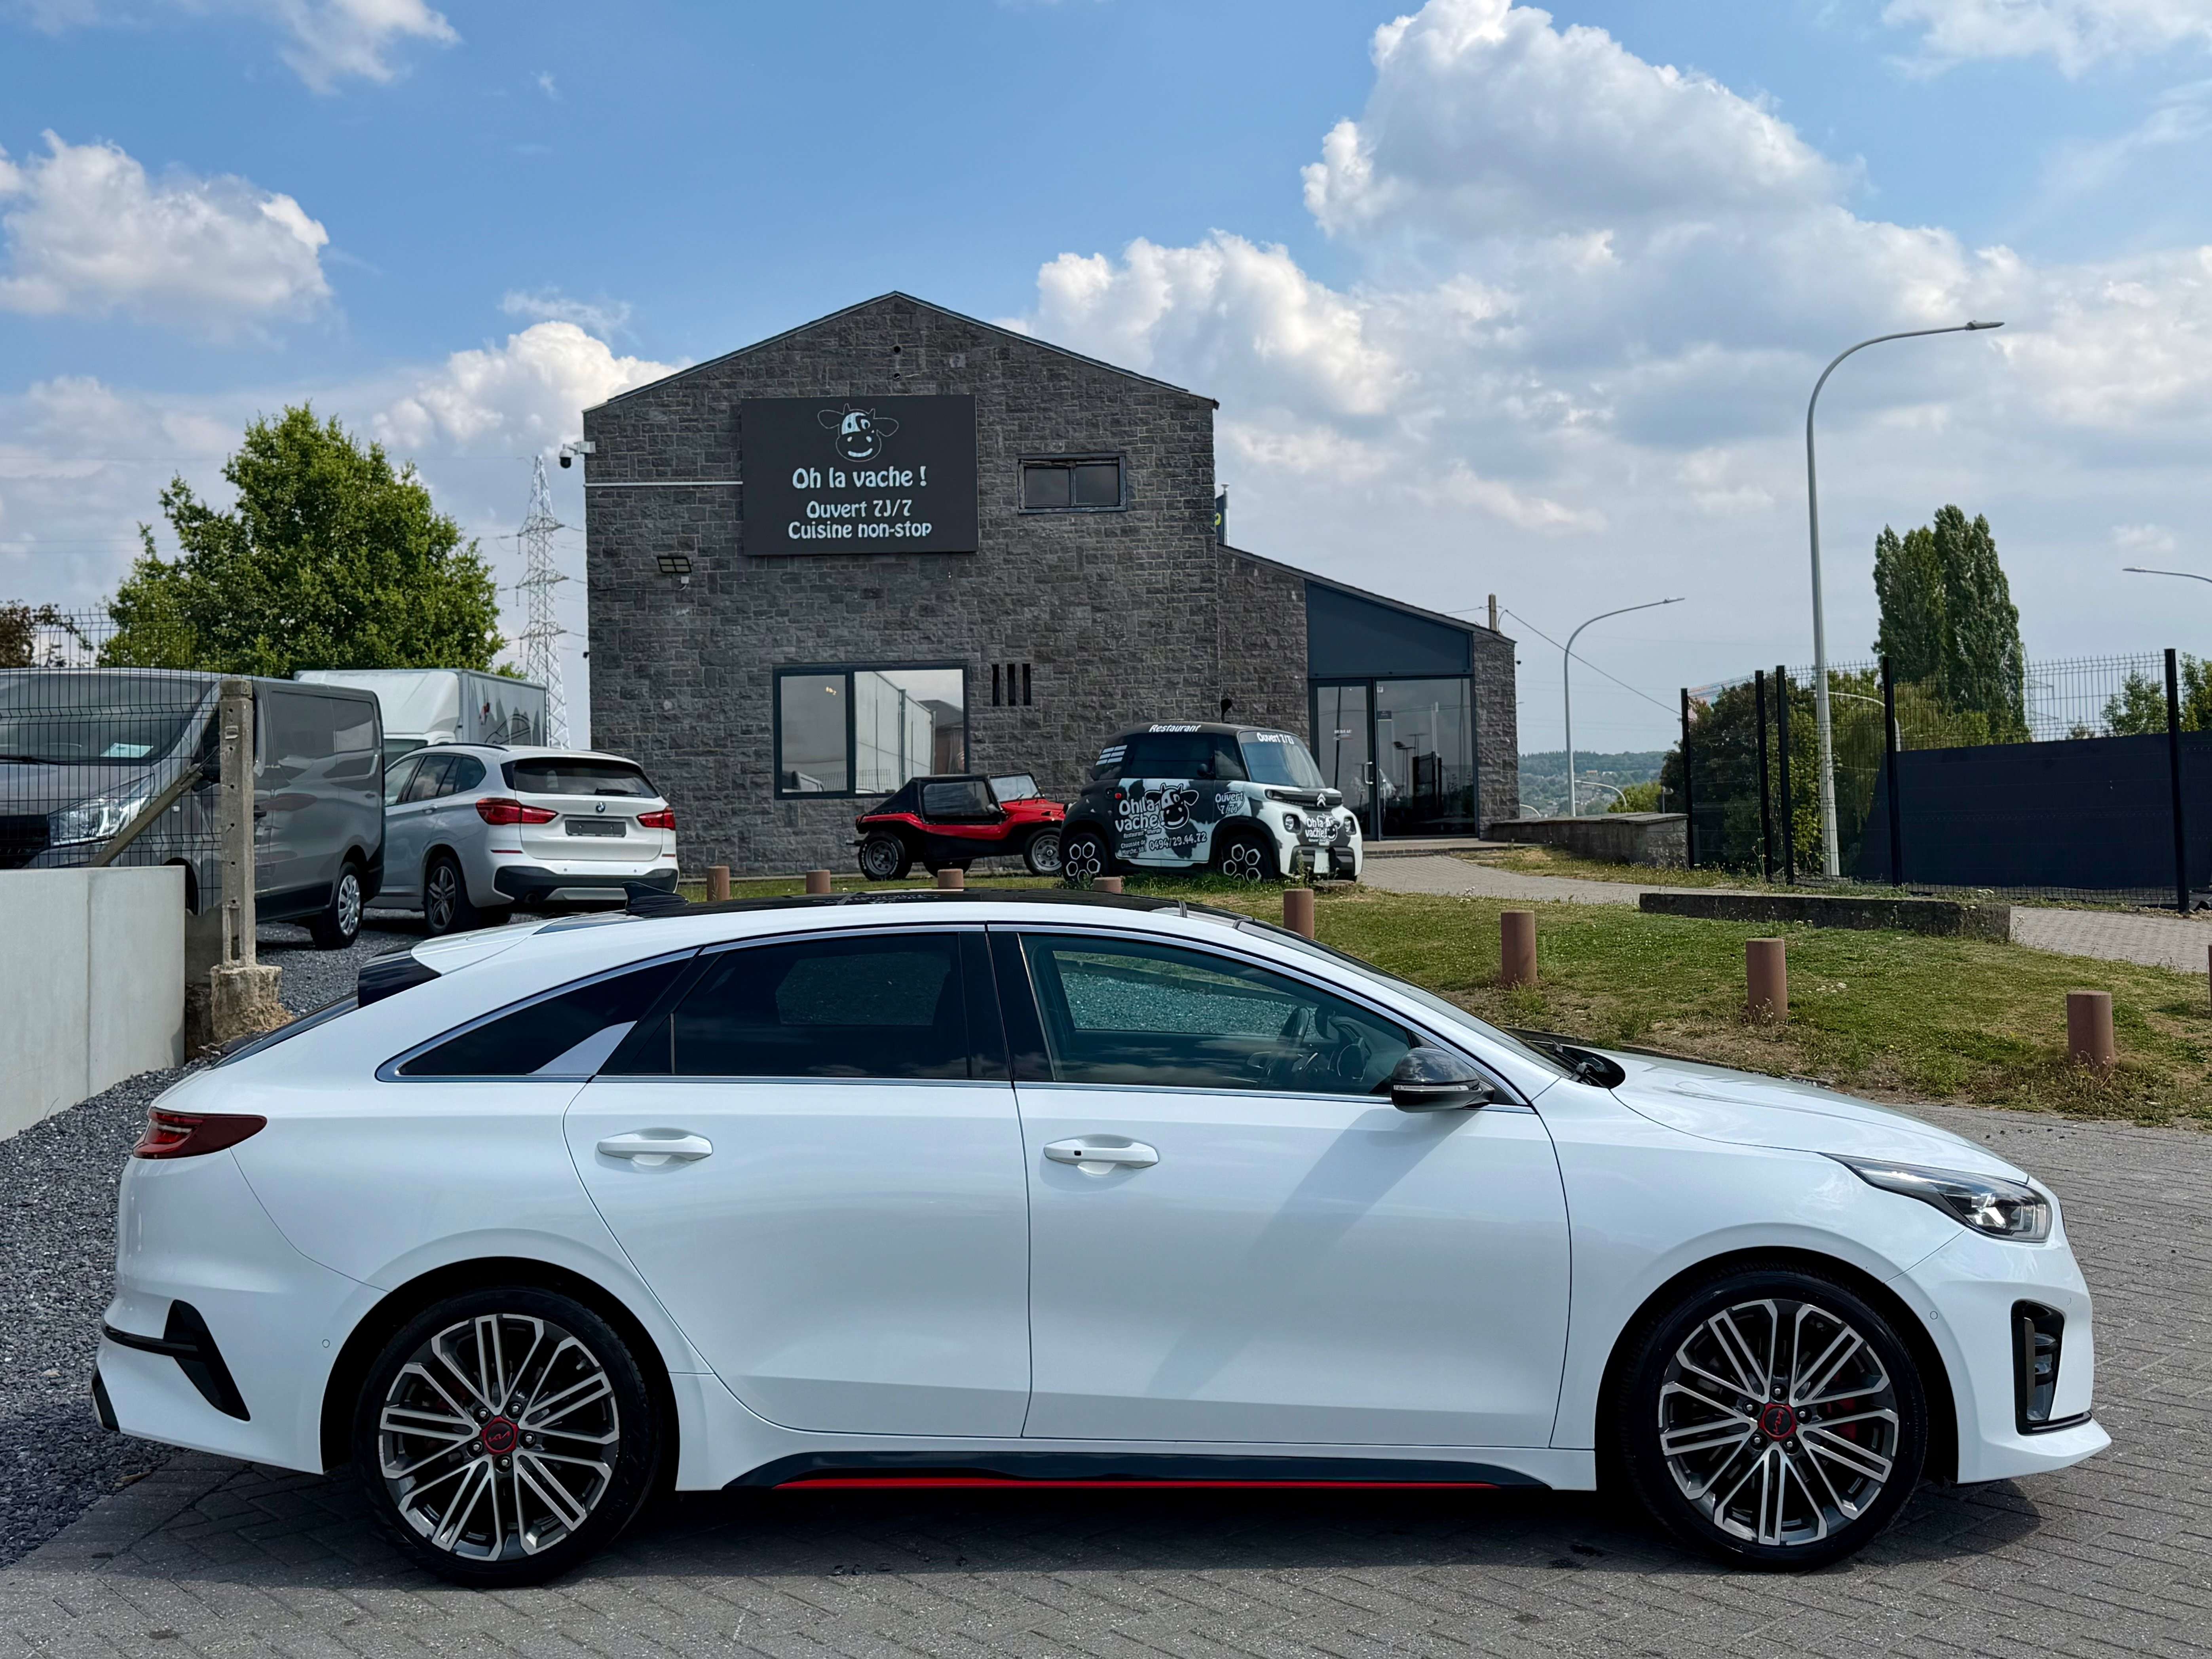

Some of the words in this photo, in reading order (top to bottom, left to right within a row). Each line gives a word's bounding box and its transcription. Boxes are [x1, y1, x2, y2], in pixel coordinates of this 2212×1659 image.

[792, 467, 821, 489] Oh
[829, 467, 846, 488] la
[853, 466, 913, 487] vache
[806, 501, 867, 519] Ouvert
[873, 499, 912, 517] 7J/7
[788, 521, 853, 540] Cuisine
[858, 521, 932, 538] non-stop
[1149, 724, 1201, 733] Restaurant
[1257, 732, 1280, 743] Ouvert
[1215, 792, 1243, 803] Ouvert
[1118, 798, 1139, 815] Oh
[1141, 796, 1155, 812] la
[1306, 817, 1317, 828] Oh
